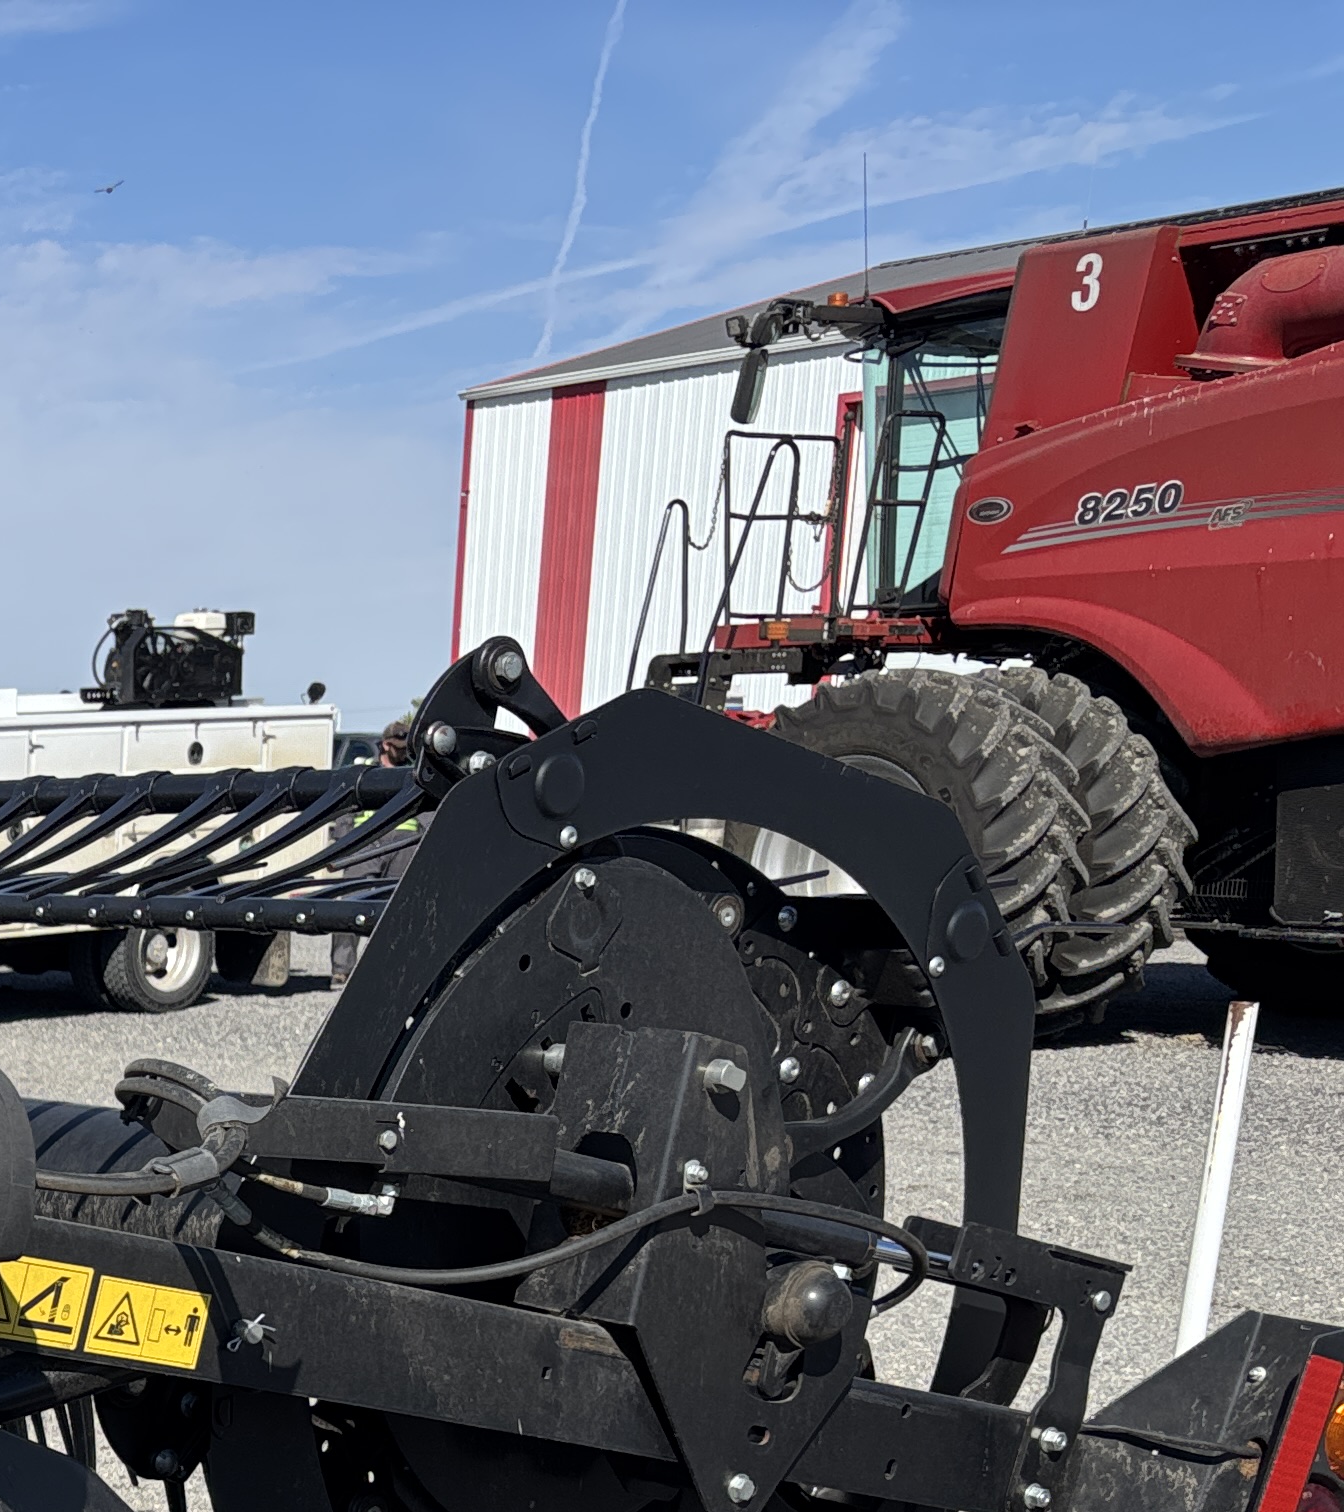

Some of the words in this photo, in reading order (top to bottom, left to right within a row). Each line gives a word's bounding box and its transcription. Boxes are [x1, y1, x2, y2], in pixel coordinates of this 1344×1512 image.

[1071, 252, 1104, 312] 3
[1075, 479, 1184, 527] 8250
[1210, 504, 1245, 523] AFS
